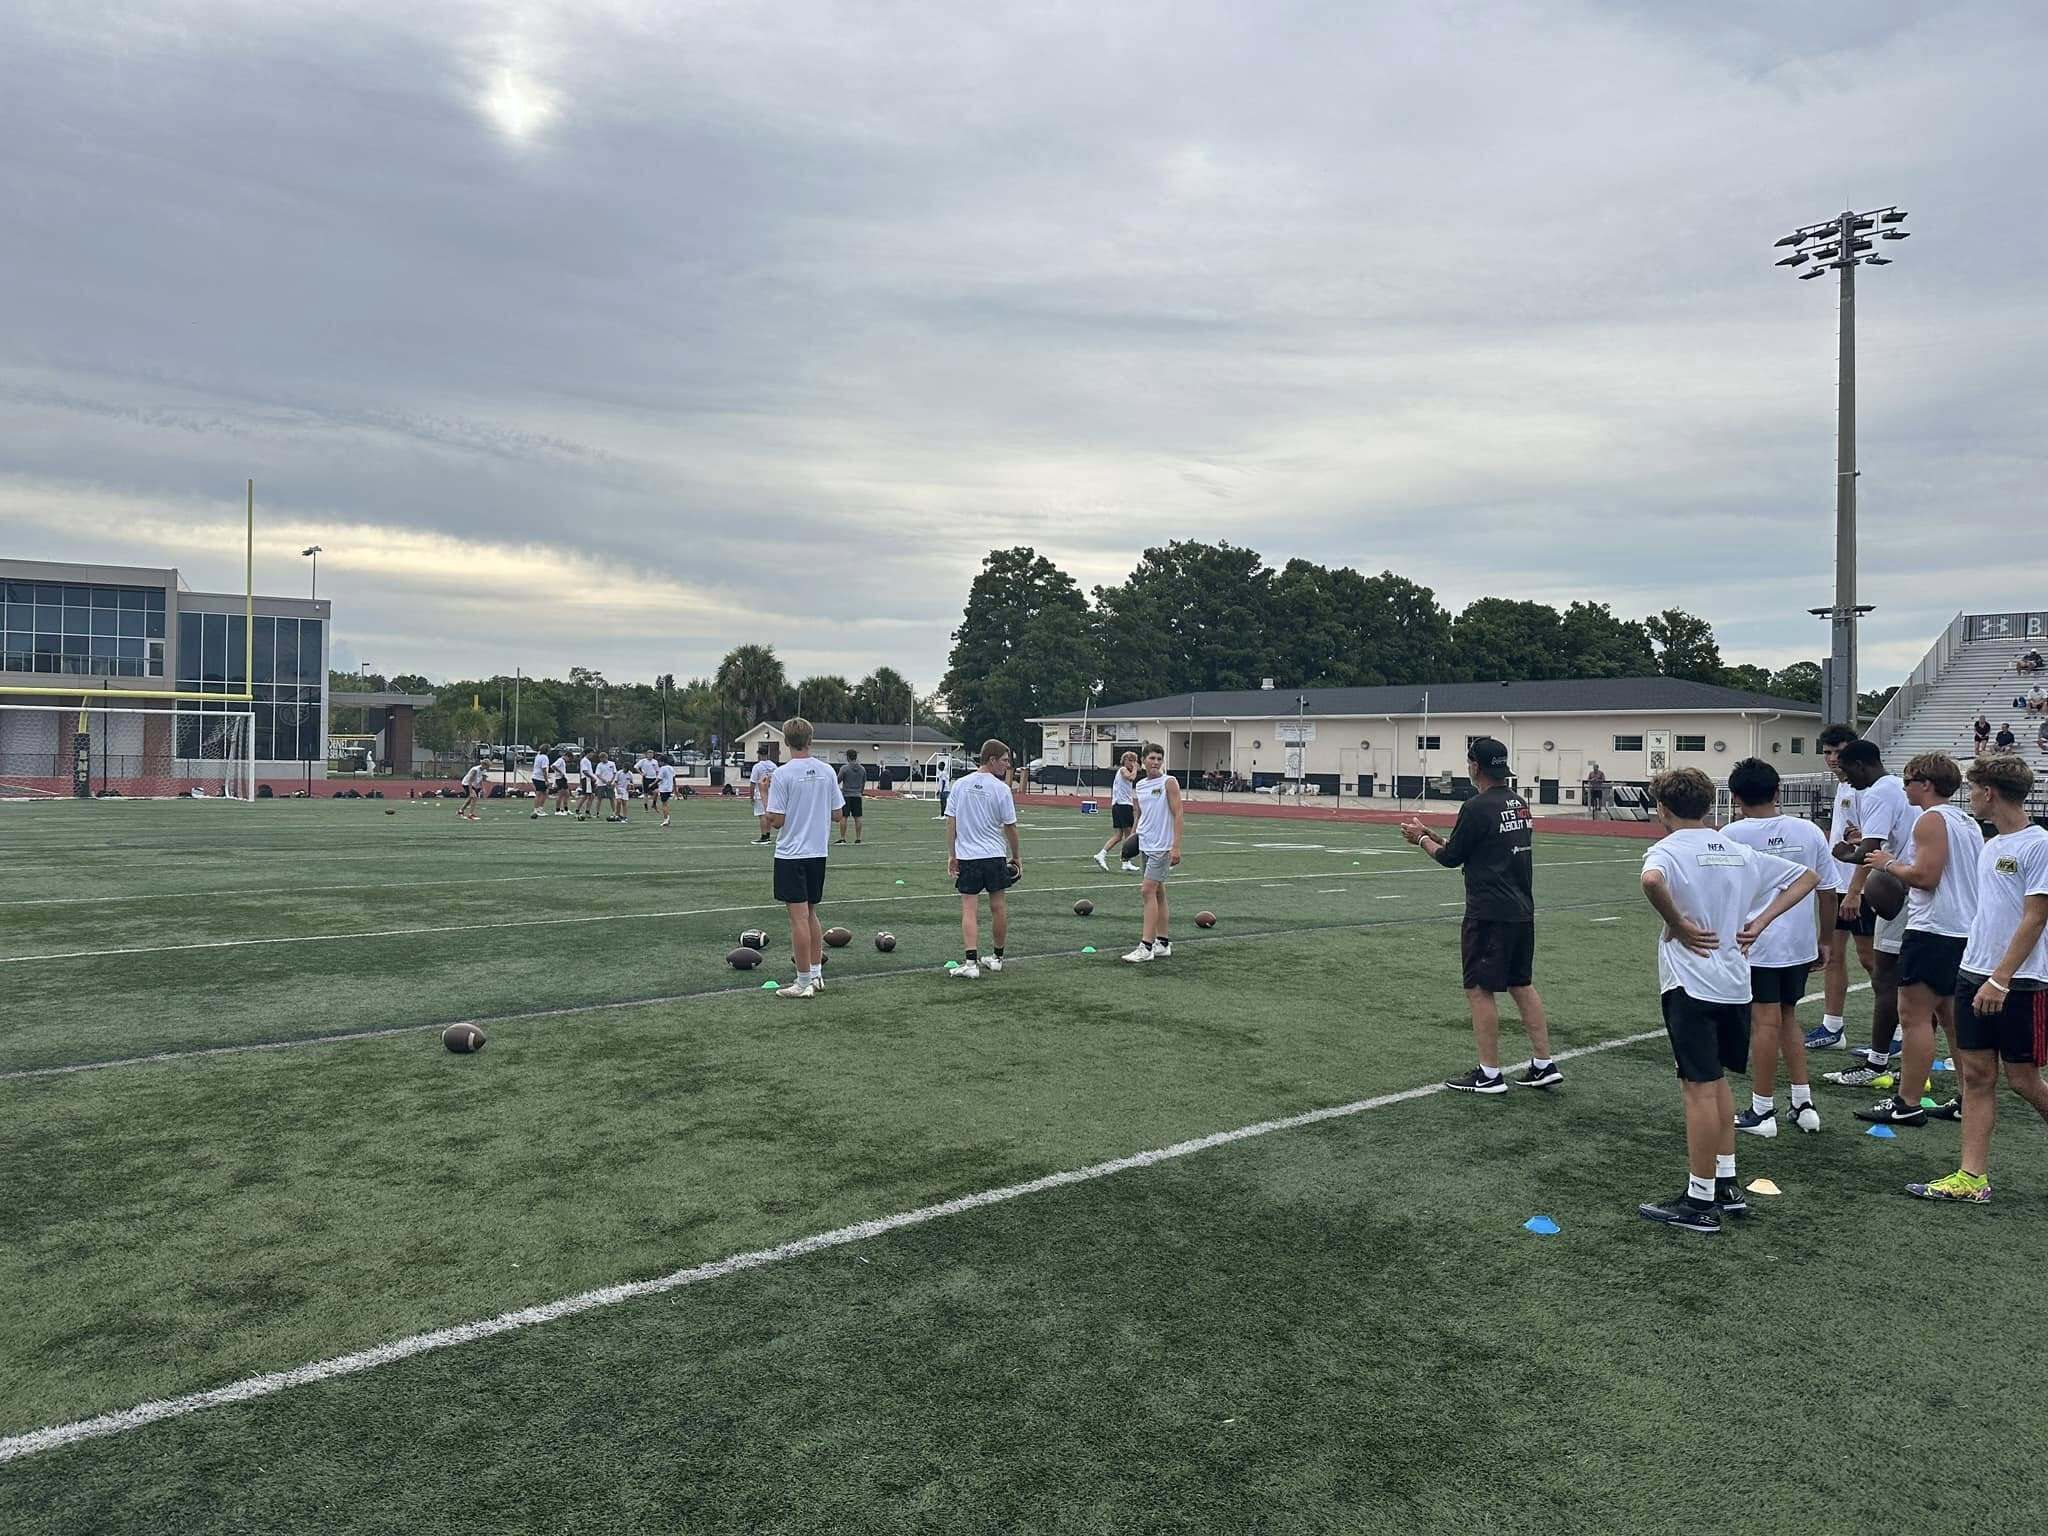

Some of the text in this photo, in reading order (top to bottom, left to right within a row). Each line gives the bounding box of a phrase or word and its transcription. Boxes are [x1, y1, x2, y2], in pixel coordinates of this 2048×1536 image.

[1499, 819, 1524, 834] ABOUT
[1768, 838, 1784, 846] NFA
[1708, 843, 1725, 851] NFA
[1998, 860, 2015, 870] NFA
